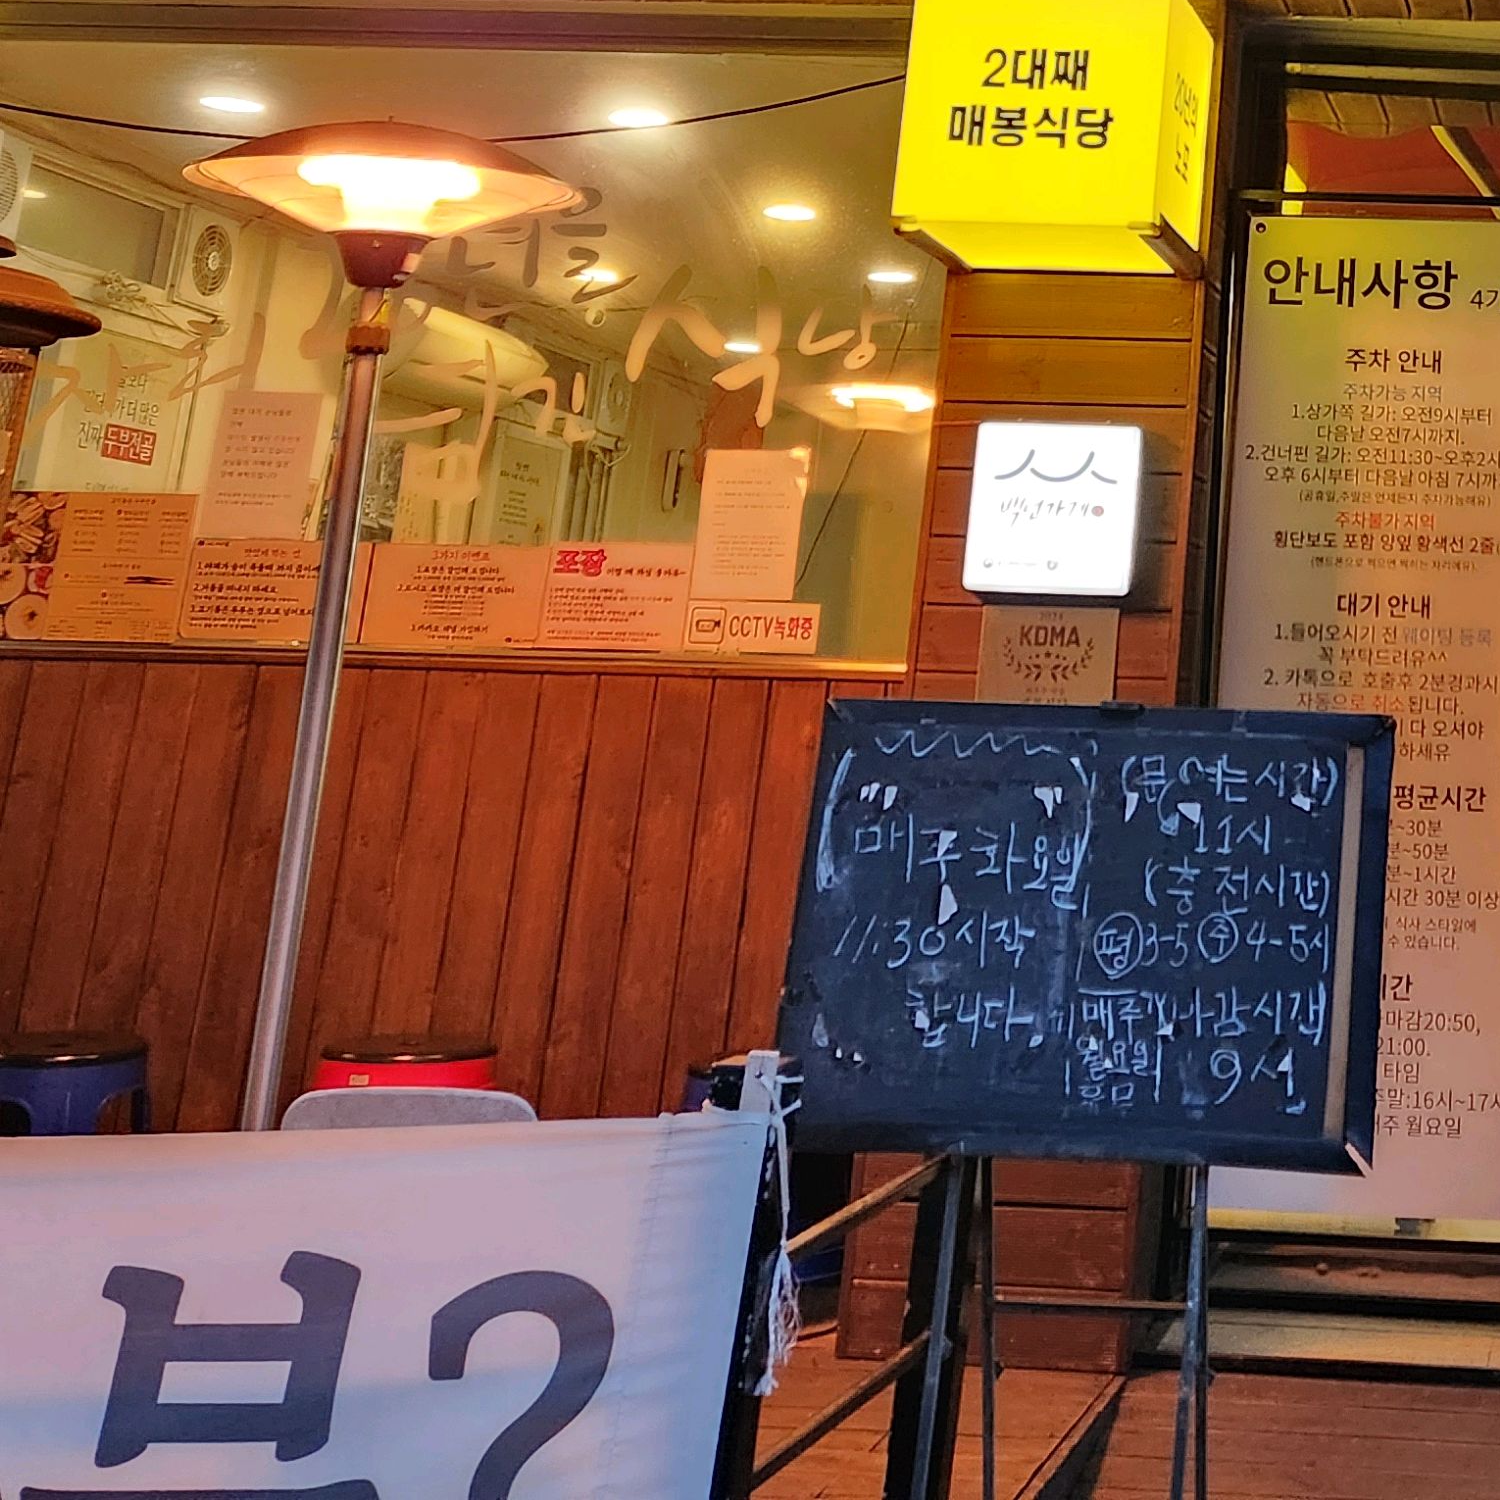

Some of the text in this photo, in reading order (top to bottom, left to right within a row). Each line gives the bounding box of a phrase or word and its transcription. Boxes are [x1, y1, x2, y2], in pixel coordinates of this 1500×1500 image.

[980, 48, 1090, 90] 2대째
[949, 104, 1114, 149] 매봉식당
[1263, 256, 1459, 311] 안내사항
[1345, 349, 1443, 375] 주차 안내
[1343, 383, 1443, 403] 주차가능 지역
[1291, 404, 1492, 426] 1.상가쪽 길가: 오전9시부터
[77, 419, 157, 464] 진짜 두부전골
[1317, 425, 1465, 446] 다음날 오전7시까지.
[1315, 446, 1352, 464] 길가:
[1264, 467, 1296, 484] 오후
[1301, 468, 1359, 486] 6시부터
[1366, 470, 1413, 487] 다음날
[1418, 471, 1450, 488] 아침
[1335, 511, 1435, 530] 주차불가 지역
[1274, 531, 1338, 549] 횡단보도
[1344, 533, 1374, 551] 포함
[1416, 535, 1464, 553] 황색선
[553, 548, 608, 577] 포장
[1336, 592, 1432, 620] 대기 안내
[1274, 623, 1492, 647] 1.들어오시기 전 웨이팅 등록
[1318, 646, 1334, 663] 꼭
[1263, 668, 1499, 694] 2. 카톡으로 호출후 2분경과시
[1297, 693, 1367, 713] 자동으로
[1410, 718, 1426, 739] 다
[1393, 784, 1487, 813] 평균시간
[1424, 889, 1461, 909] 30분
[1466, 890, 1500, 911] 이상
[1395, 916, 1421, 932] 식사
[1387, 934, 1460, 951] 수 있습니다.
[1383, 1062, 1421, 1085] 타임
[1406, 1115, 1463, 1139] 월요일
